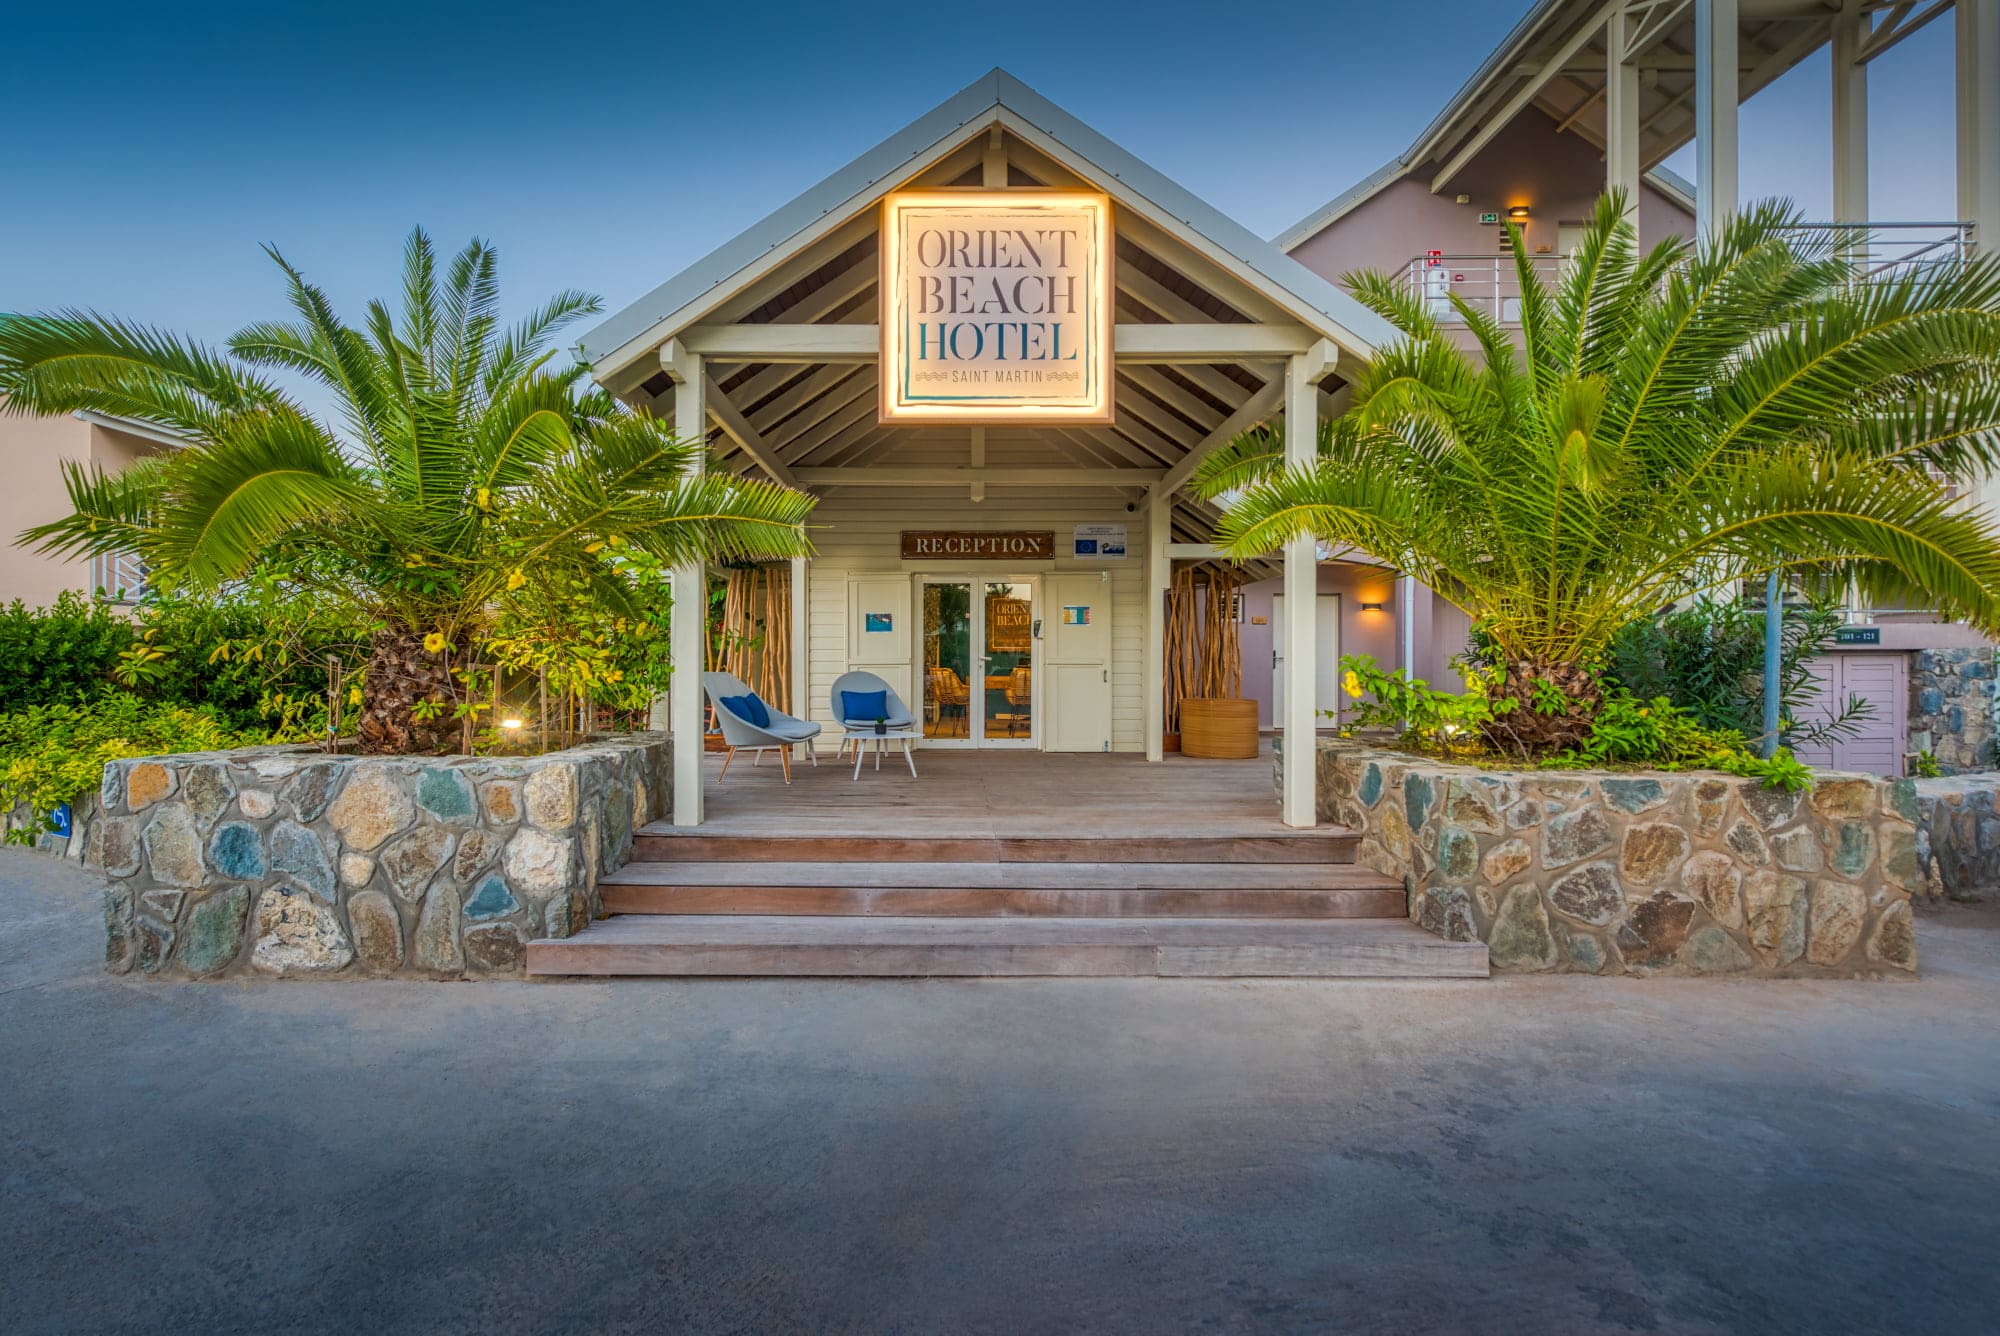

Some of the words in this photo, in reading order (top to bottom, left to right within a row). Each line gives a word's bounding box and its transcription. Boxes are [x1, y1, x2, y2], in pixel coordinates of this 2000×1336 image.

[917, 229, 1077, 268] ORIENT
[917, 275, 1077, 314] BEACH
[917, 322, 1077, 360] HOTEL
[952, 370, 989, 383] SAINT
[995, 370, 1042, 383] MARTIN
[916, 537, 1041, 553] RECEPTION
[996, 603, 1027, 614] ORIEN
